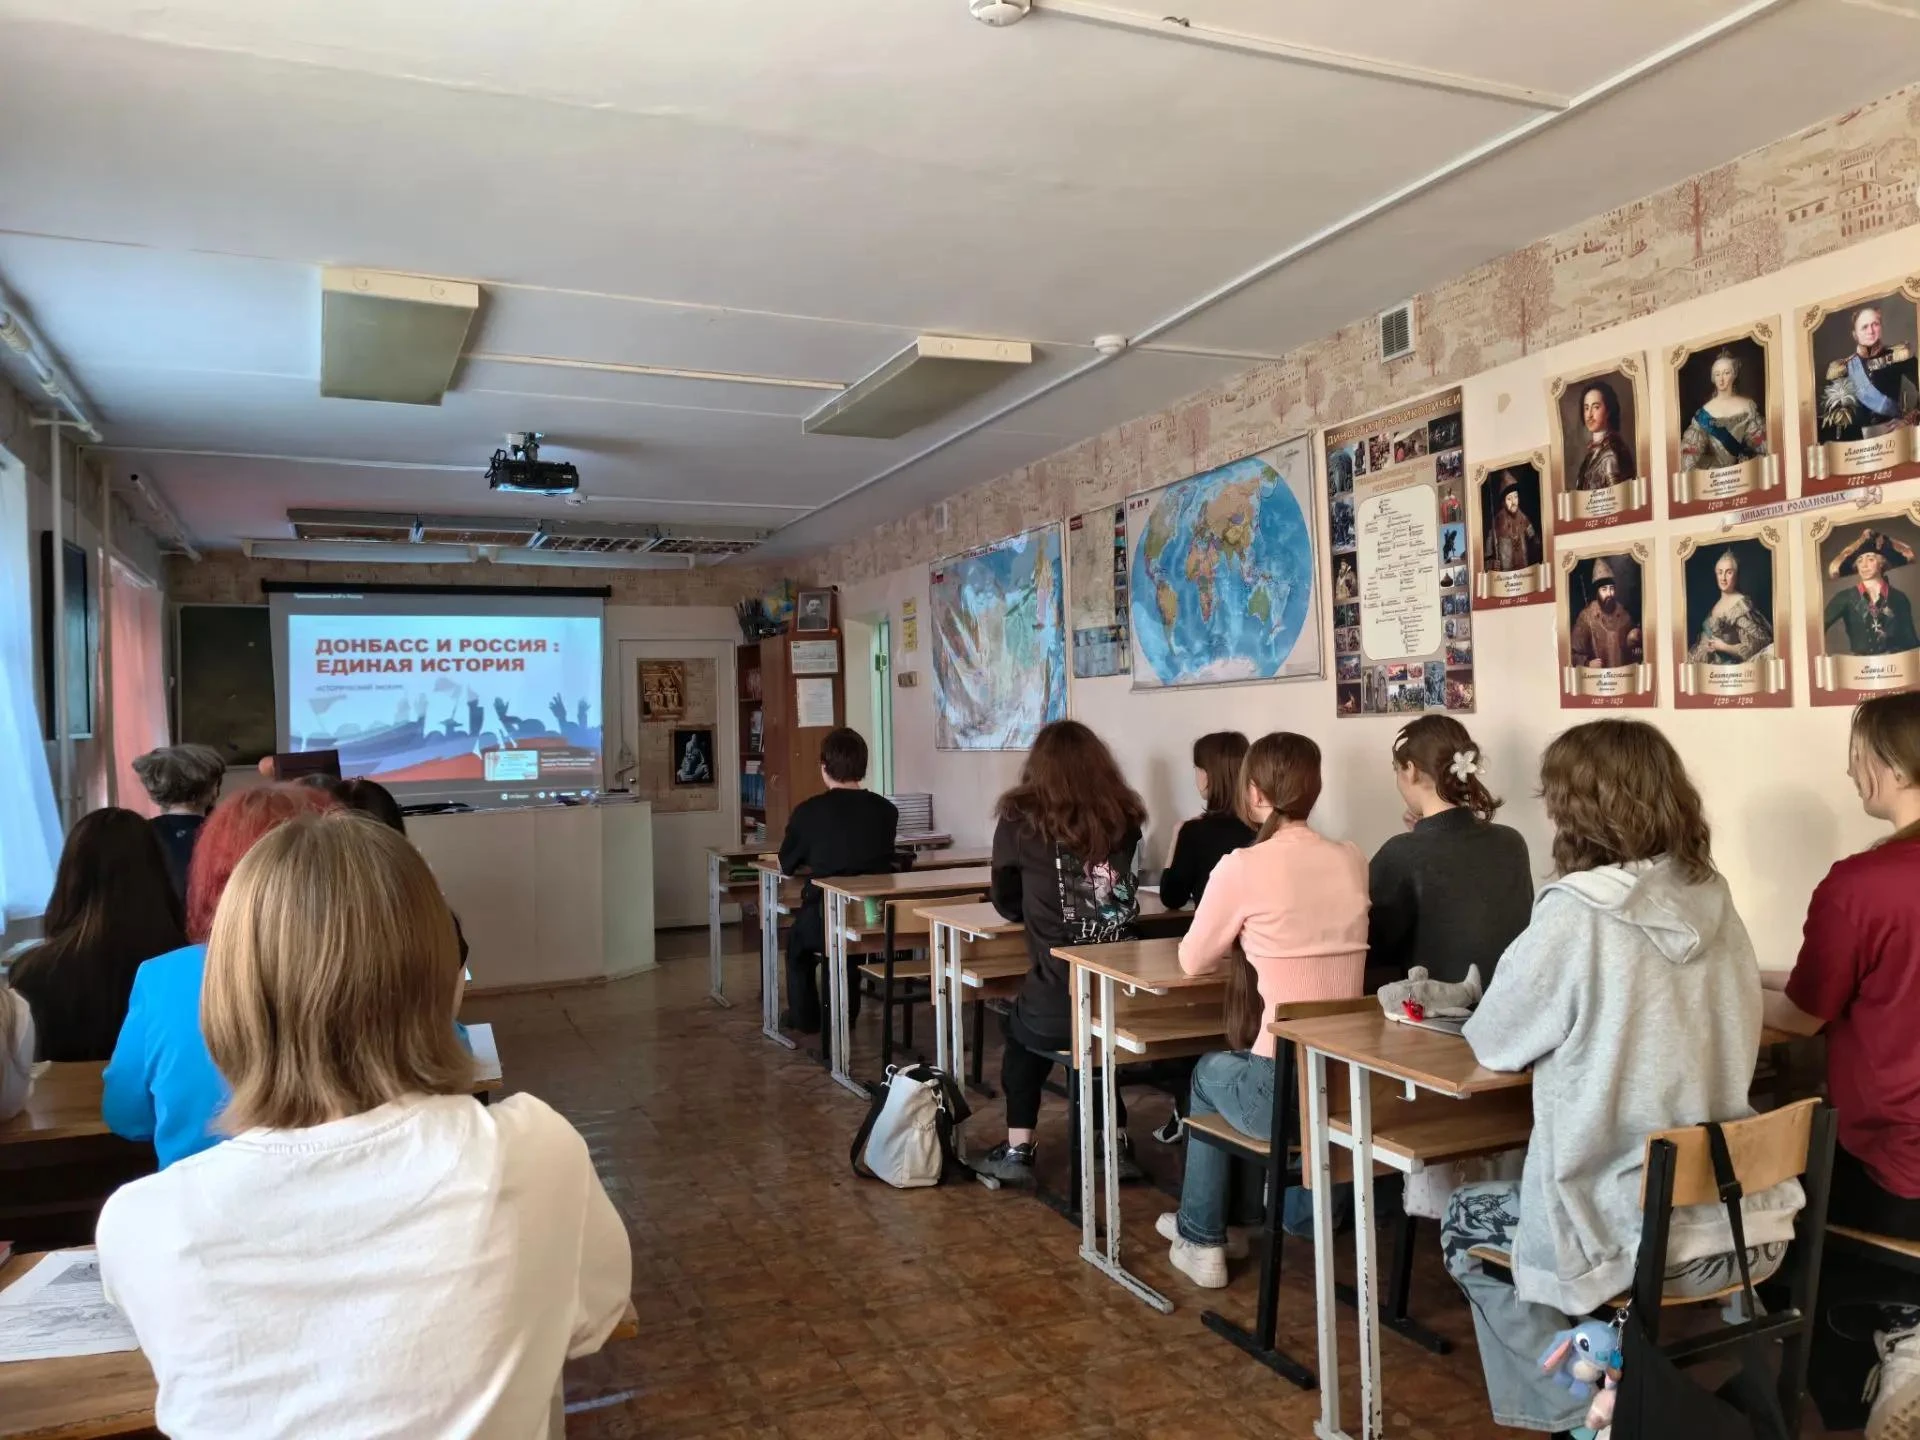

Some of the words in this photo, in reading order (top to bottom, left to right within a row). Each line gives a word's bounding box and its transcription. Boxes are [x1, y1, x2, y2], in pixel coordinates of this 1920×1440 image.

[1787, 492, 1847, 512] РОМАНОВЫХ
[315, 638, 429, 656] ДОНБАСС
[436, 638, 452, 653] И
[459, 638, 547, 653] РОССИЯ
[316, 658, 413, 677] ЕДИНАЯ
[421, 657, 526, 673] ИСТОРИЯ
